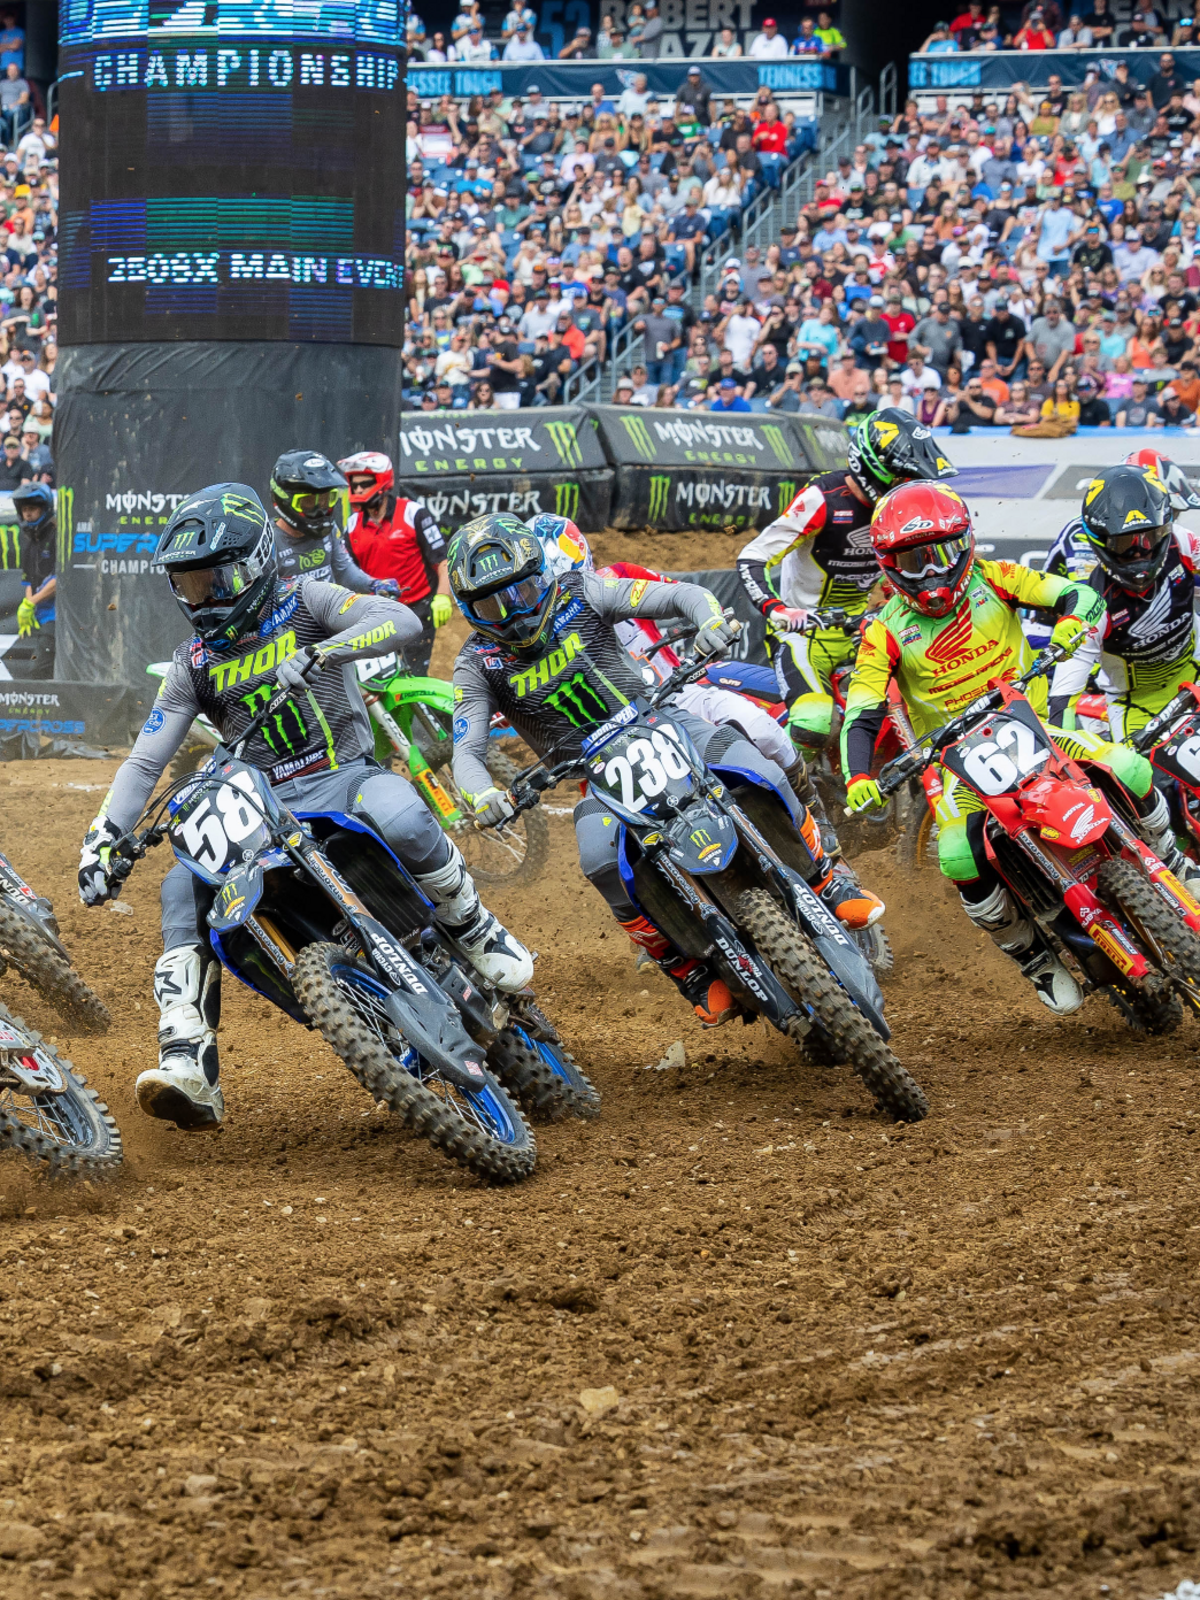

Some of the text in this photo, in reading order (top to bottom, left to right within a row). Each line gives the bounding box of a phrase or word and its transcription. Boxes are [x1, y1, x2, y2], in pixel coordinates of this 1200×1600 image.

[602, 0, 757, 30] RBERT
[230, 253, 327, 284] MAIN
[653, 418, 764, 451] MONSTER
[415, 457, 523, 472] ENERGY
[685, 450, 756, 465] ENERGY
[676, 478, 772, 511] MONSTER
[73, 533, 161, 554] SUPER
[76, 522, 93, 533] AMA
[842, 546, 876, 557] HON
[349, 619, 397, 651] THOR
[208, 630, 298, 698] THOR
[509, 632, 586, 698] THOR
[931, 639, 999, 679] HONDA
[604, 723, 692, 814] 238
[963, 719, 1051, 797] 62
[182, 770, 266, 874] 58
[793, 883, 849, 946] DUNLOP
[249, 917, 285, 964] nzoracing
[370, 933, 429, 995] DUNLOP
[715, 936, 768, 1002] DUNLOP
